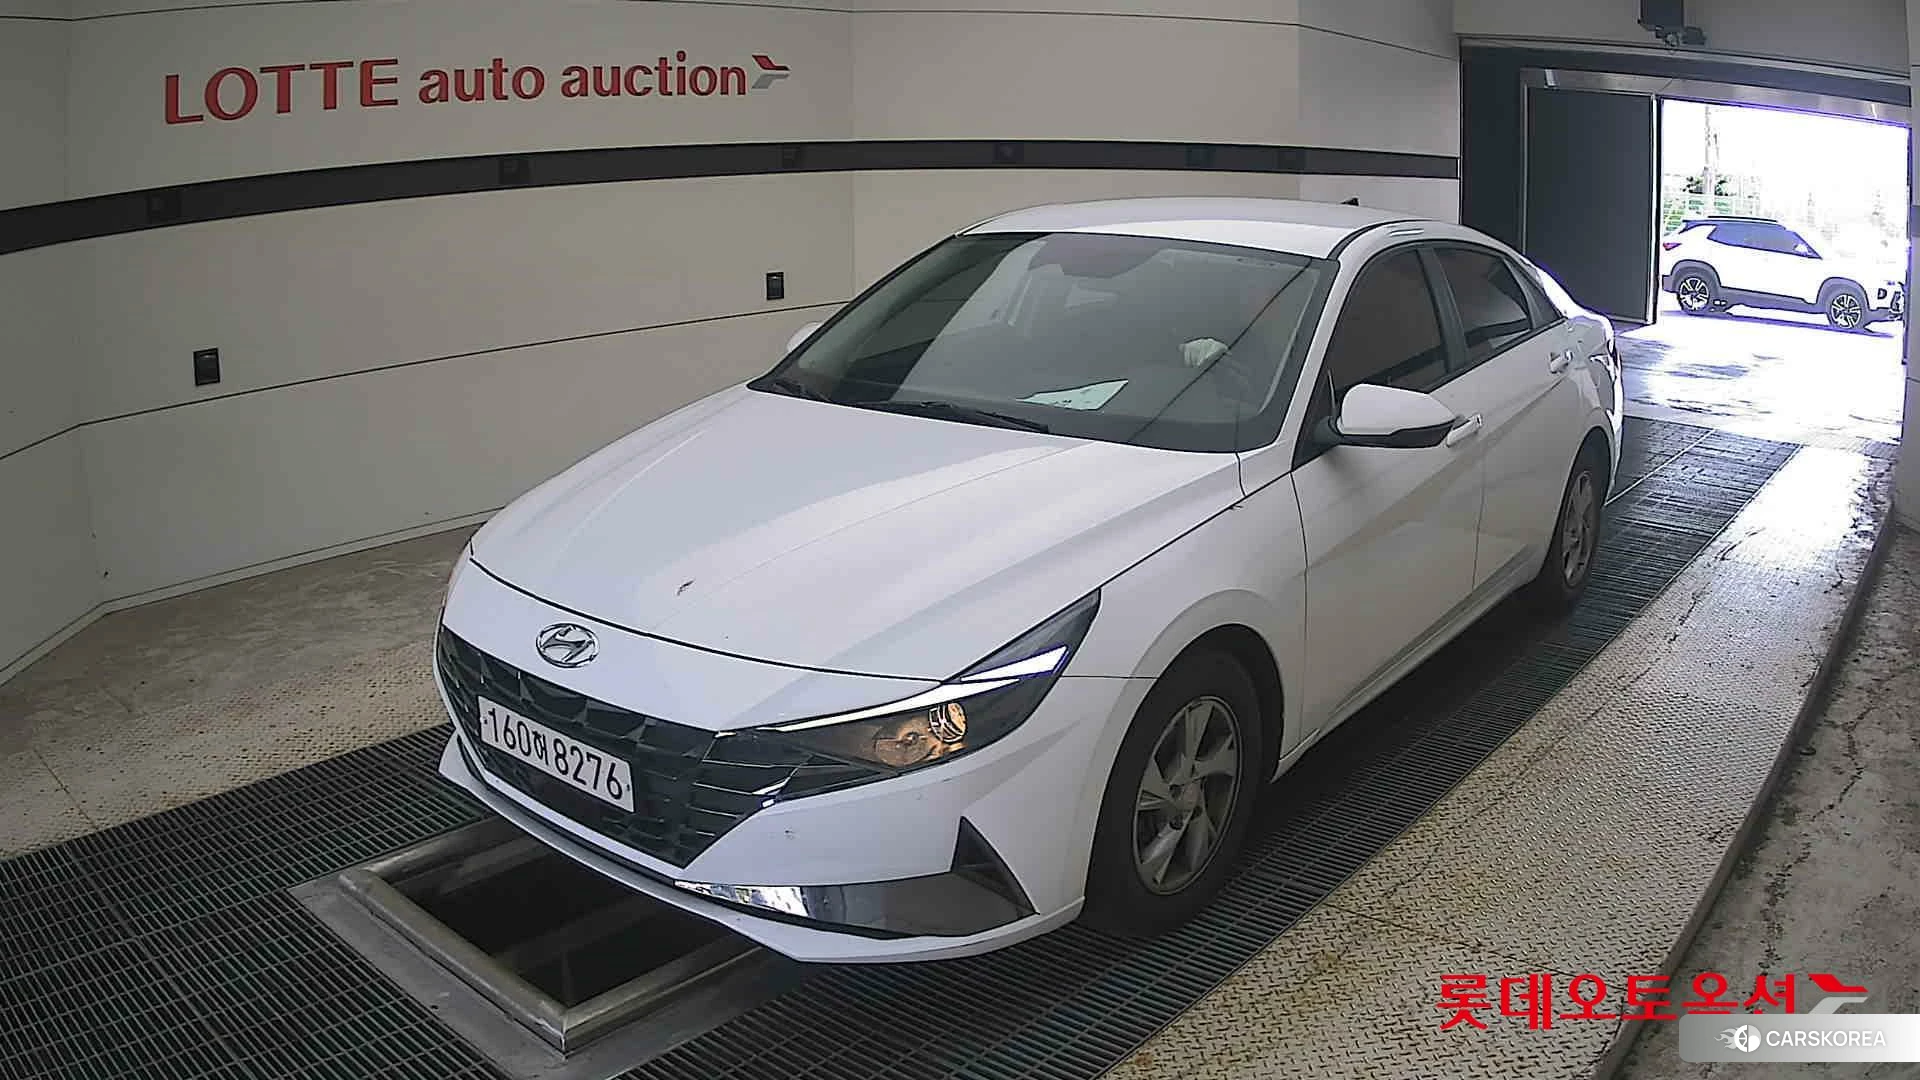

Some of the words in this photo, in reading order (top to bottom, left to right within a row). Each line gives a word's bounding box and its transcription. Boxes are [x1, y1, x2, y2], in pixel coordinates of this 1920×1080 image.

[164, 57, 400, 125] LOTTE
[417, 57, 547, 104] auto
[559, 50, 748, 98] auction
